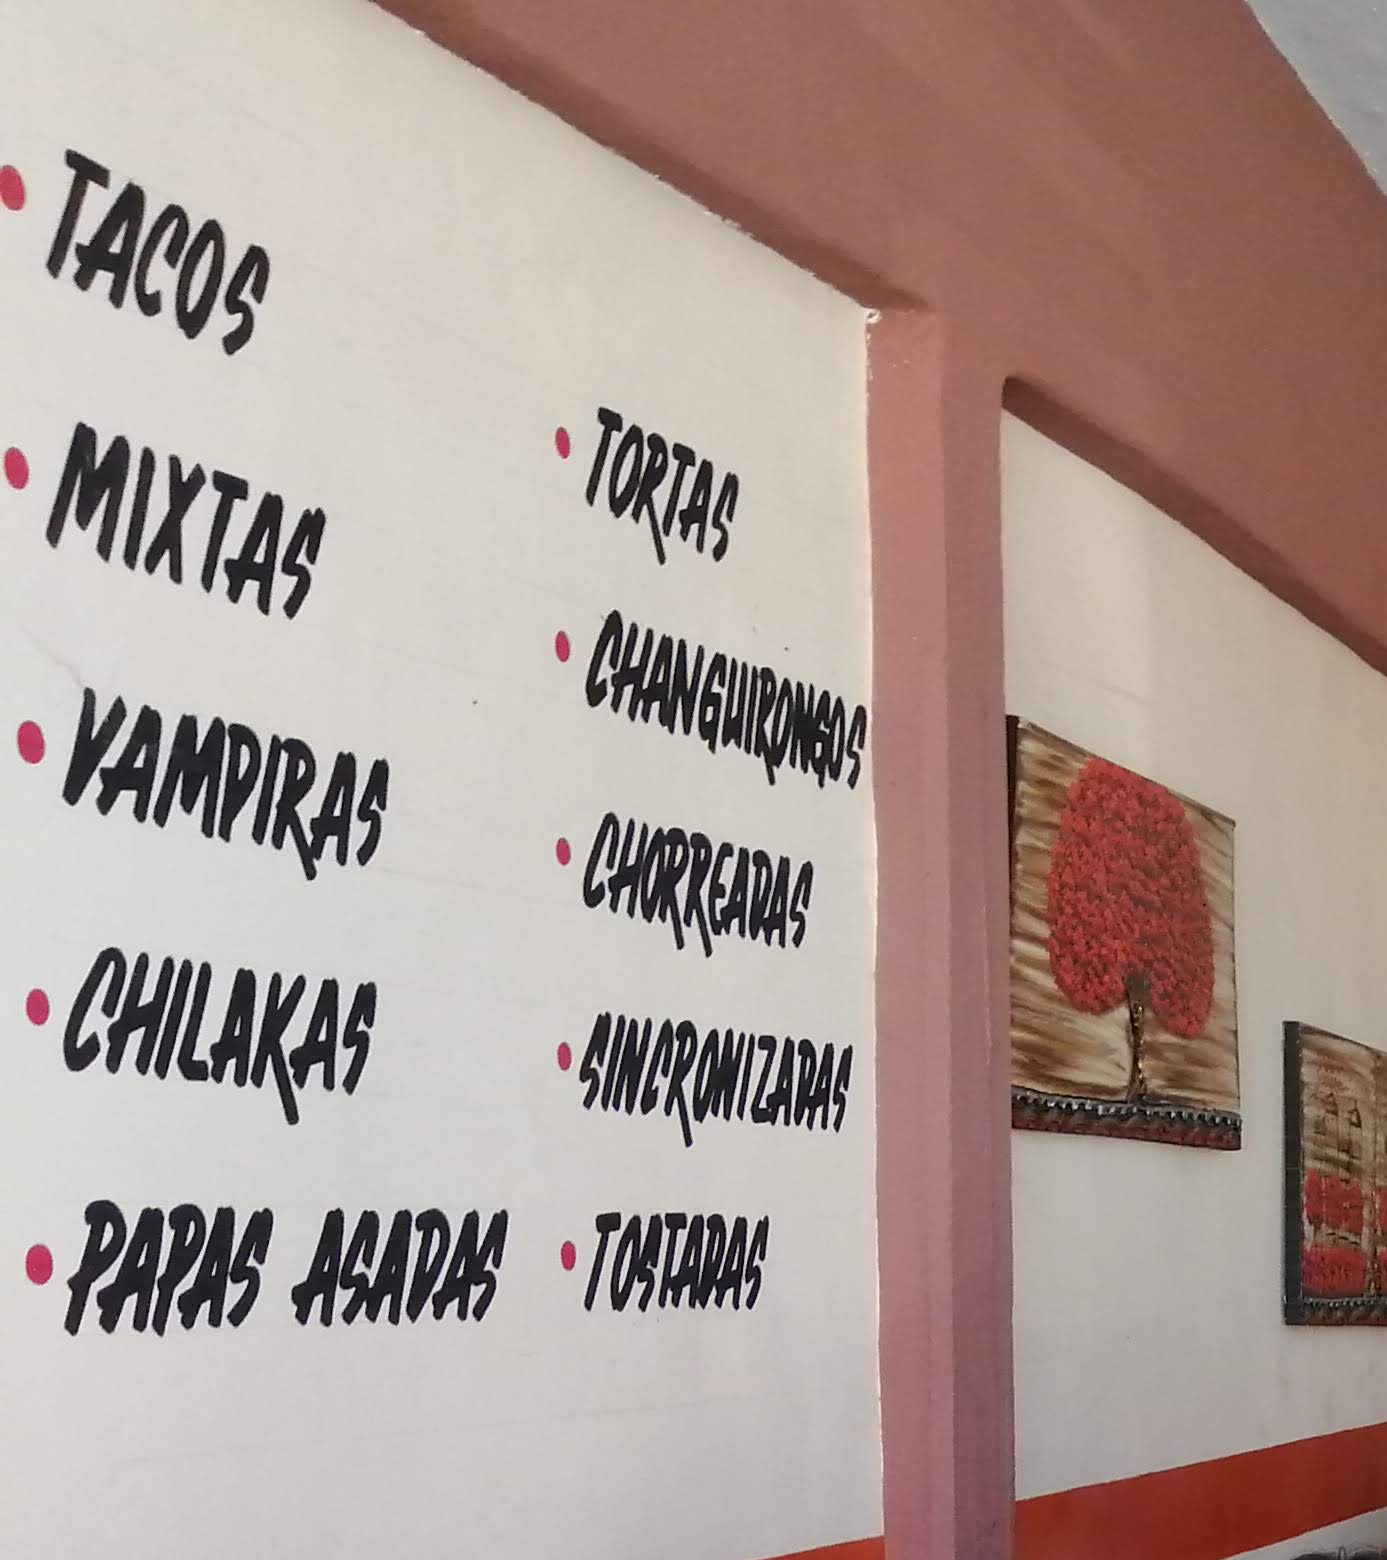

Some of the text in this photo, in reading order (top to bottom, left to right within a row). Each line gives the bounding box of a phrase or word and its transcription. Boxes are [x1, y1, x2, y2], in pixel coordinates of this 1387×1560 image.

[47, 150, 270, 355] TACOS
[46, 422, 326, 620] MIXTAS
[586, 408, 739, 565] TORTAS
[585, 609, 867, 790] CHANGUIRONGOS
[62, 687, 389, 881] VAMPIRAS
[583, 812, 814, 958] CHORREADAS
[63, 947, 377, 1125] CHILAKAS
[579, 1011, 853, 1148] SINCRONIZADAS
[64, 1199, 509, 1337] PAPAS ASADAS
[584, 1212, 770, 1313] TOSTADAS
